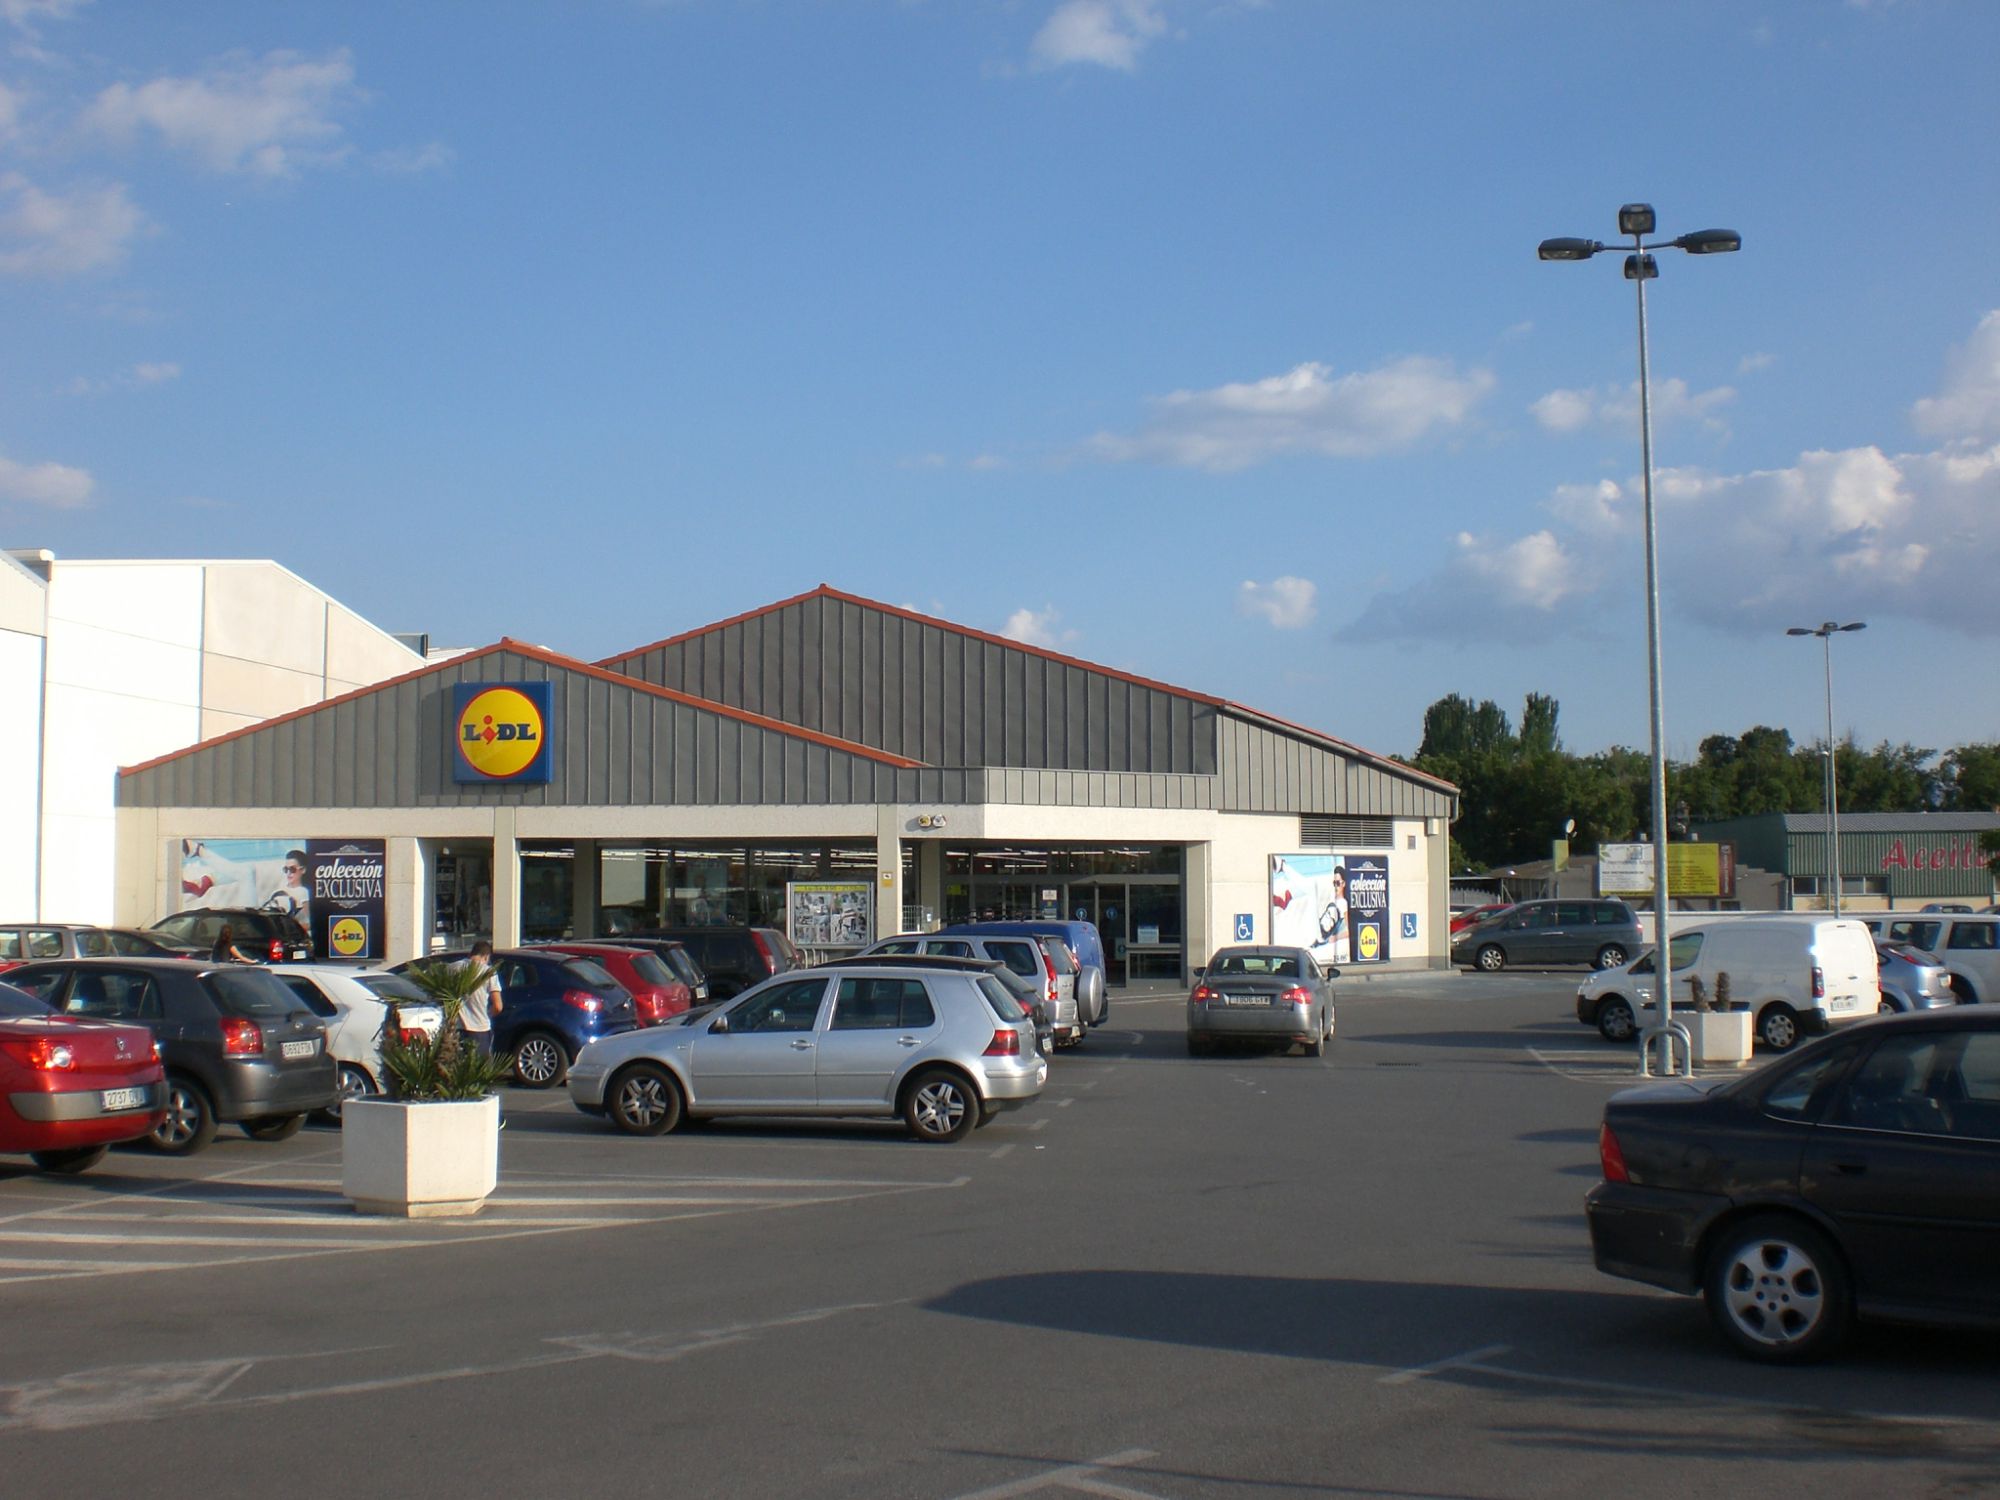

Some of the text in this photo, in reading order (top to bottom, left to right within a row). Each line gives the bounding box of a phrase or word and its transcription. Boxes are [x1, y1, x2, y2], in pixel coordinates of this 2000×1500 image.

[315, 858, 383, 879] colección
[315, 879, 383, 898] EXCLUSIVA
[1350, 891, 1387, 908] EXCLUSIVA
